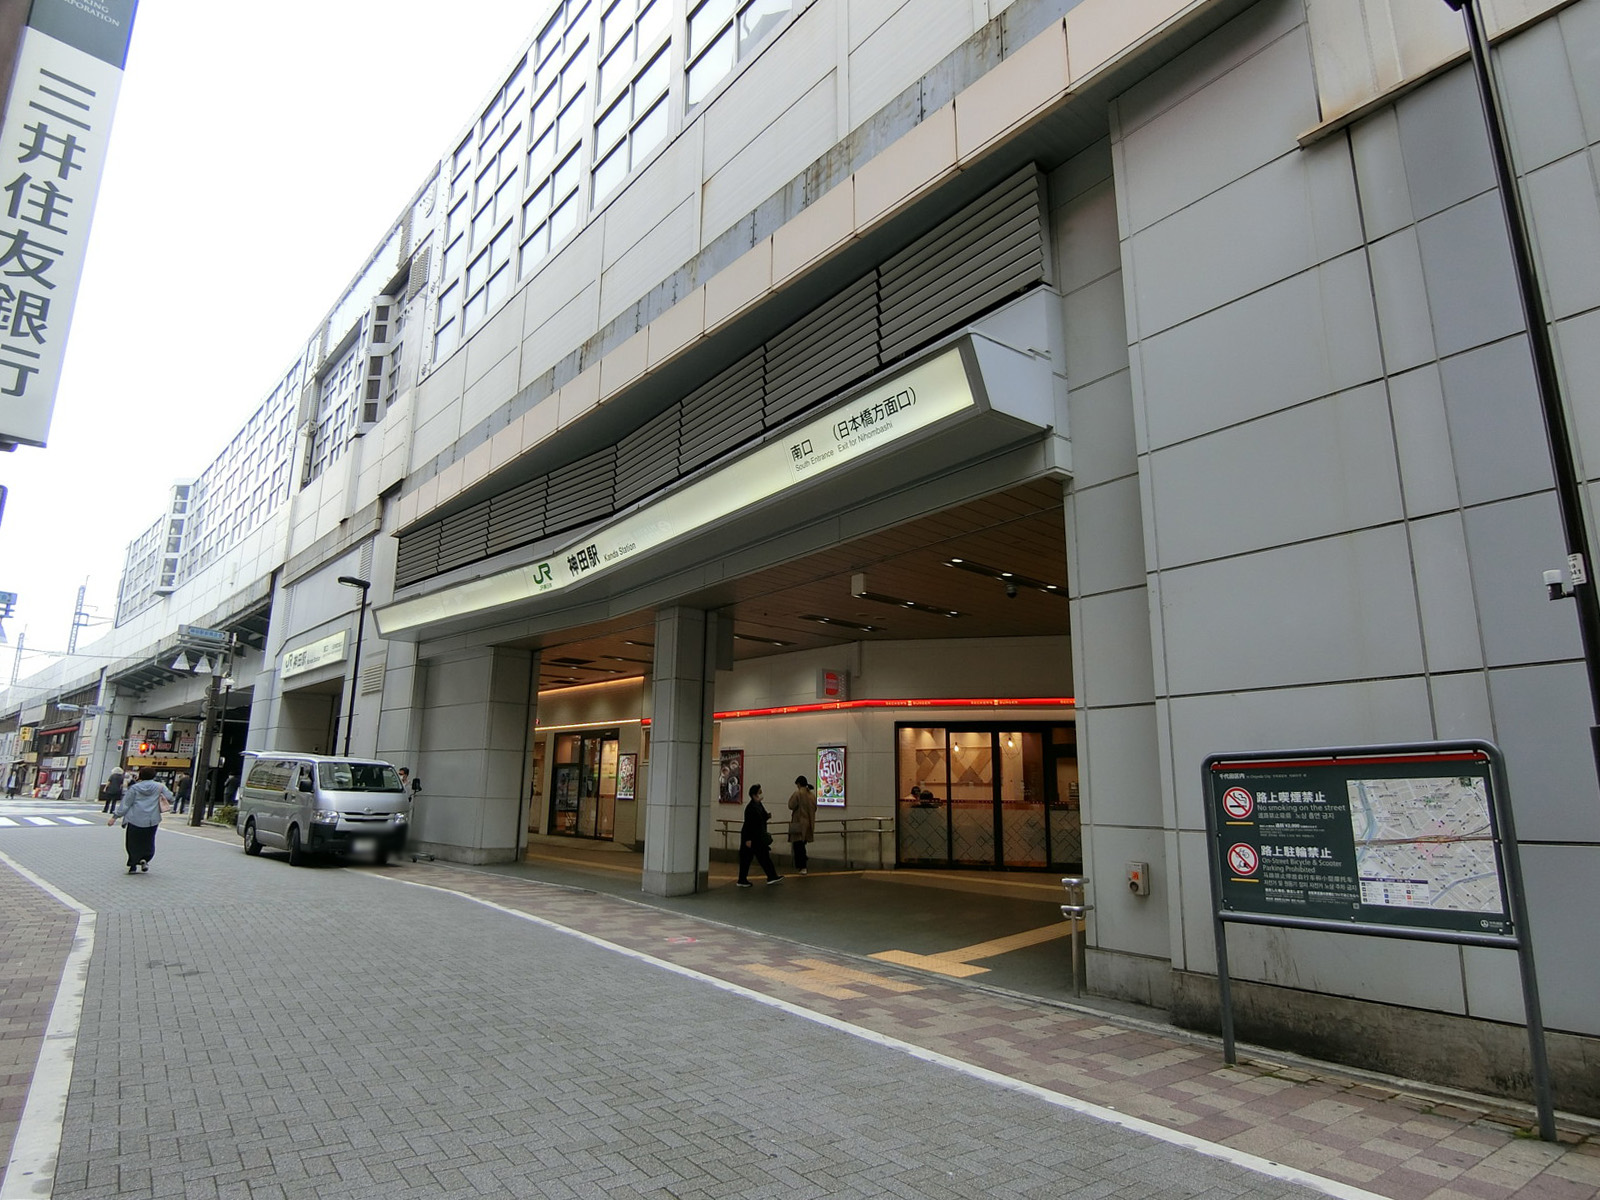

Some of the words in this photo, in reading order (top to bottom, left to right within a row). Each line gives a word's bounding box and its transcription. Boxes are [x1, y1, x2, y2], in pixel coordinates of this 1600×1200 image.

[790, 439, 814, 461] 南口
[833, 386, 917, 441] （日本橋方面口）
[795, 460, 811, 472] South
[811, 449, 834, 465] Entrance
[837, 442, 850, 453] Exit
[849, 438, 857, 448] for
[858, 421, 894, 443] Nihombashi
[567, 543, 601, 577] 神田駅
[603, 549, 620, 562] Kanda
[618, 542, 637, 555] Station
[533, 562, 553, 585] JR
[1256, 791, 1327, 803] 路上喫煙禁止
[1268, 804, 1298, 812] smoking
[1260, 845, 1332, 859] 路上駐輪禁止
[1290, 859, 1311, 867] Bicycle
